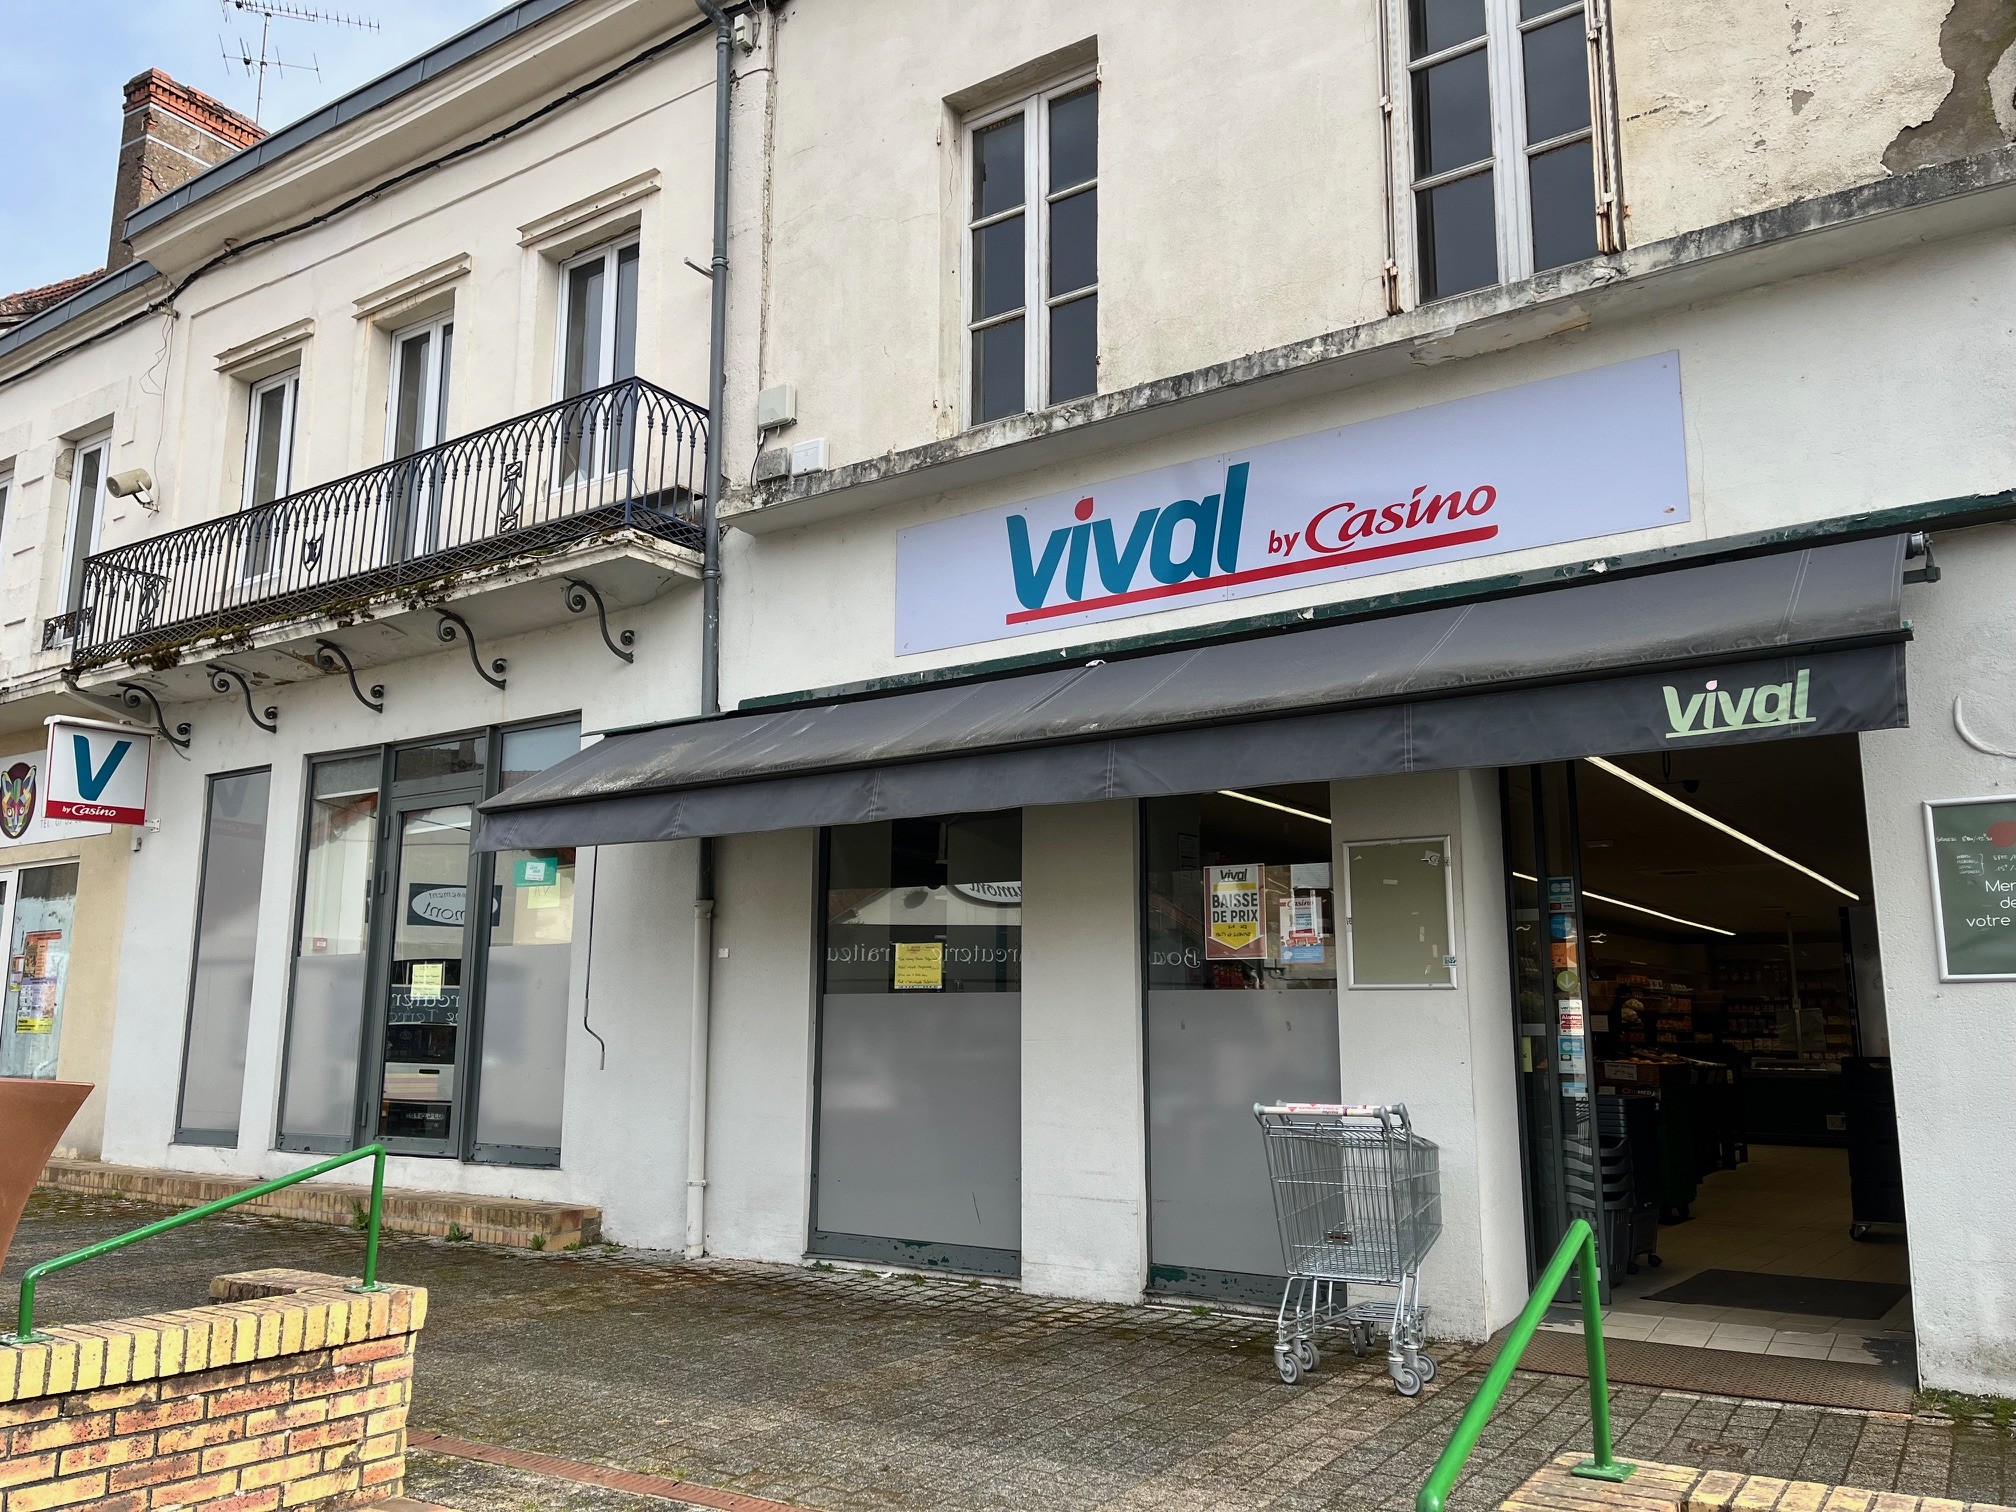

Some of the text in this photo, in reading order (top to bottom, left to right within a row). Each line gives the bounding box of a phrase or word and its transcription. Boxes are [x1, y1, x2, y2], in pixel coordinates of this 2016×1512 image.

[1006, 461, 1497, 610] vival by Casino
[1662, 668, 1810, 733] vival
[73, 734, 133, 802] V
[61, 804, 117, 817] by Casino
[1219, 868, 1248, 882] vival
[1212, 892, 1259, 909] BAISSE
[1212, 909, 1259, 923] DE PRIX
[1965, 914, 2011, 928] votre
